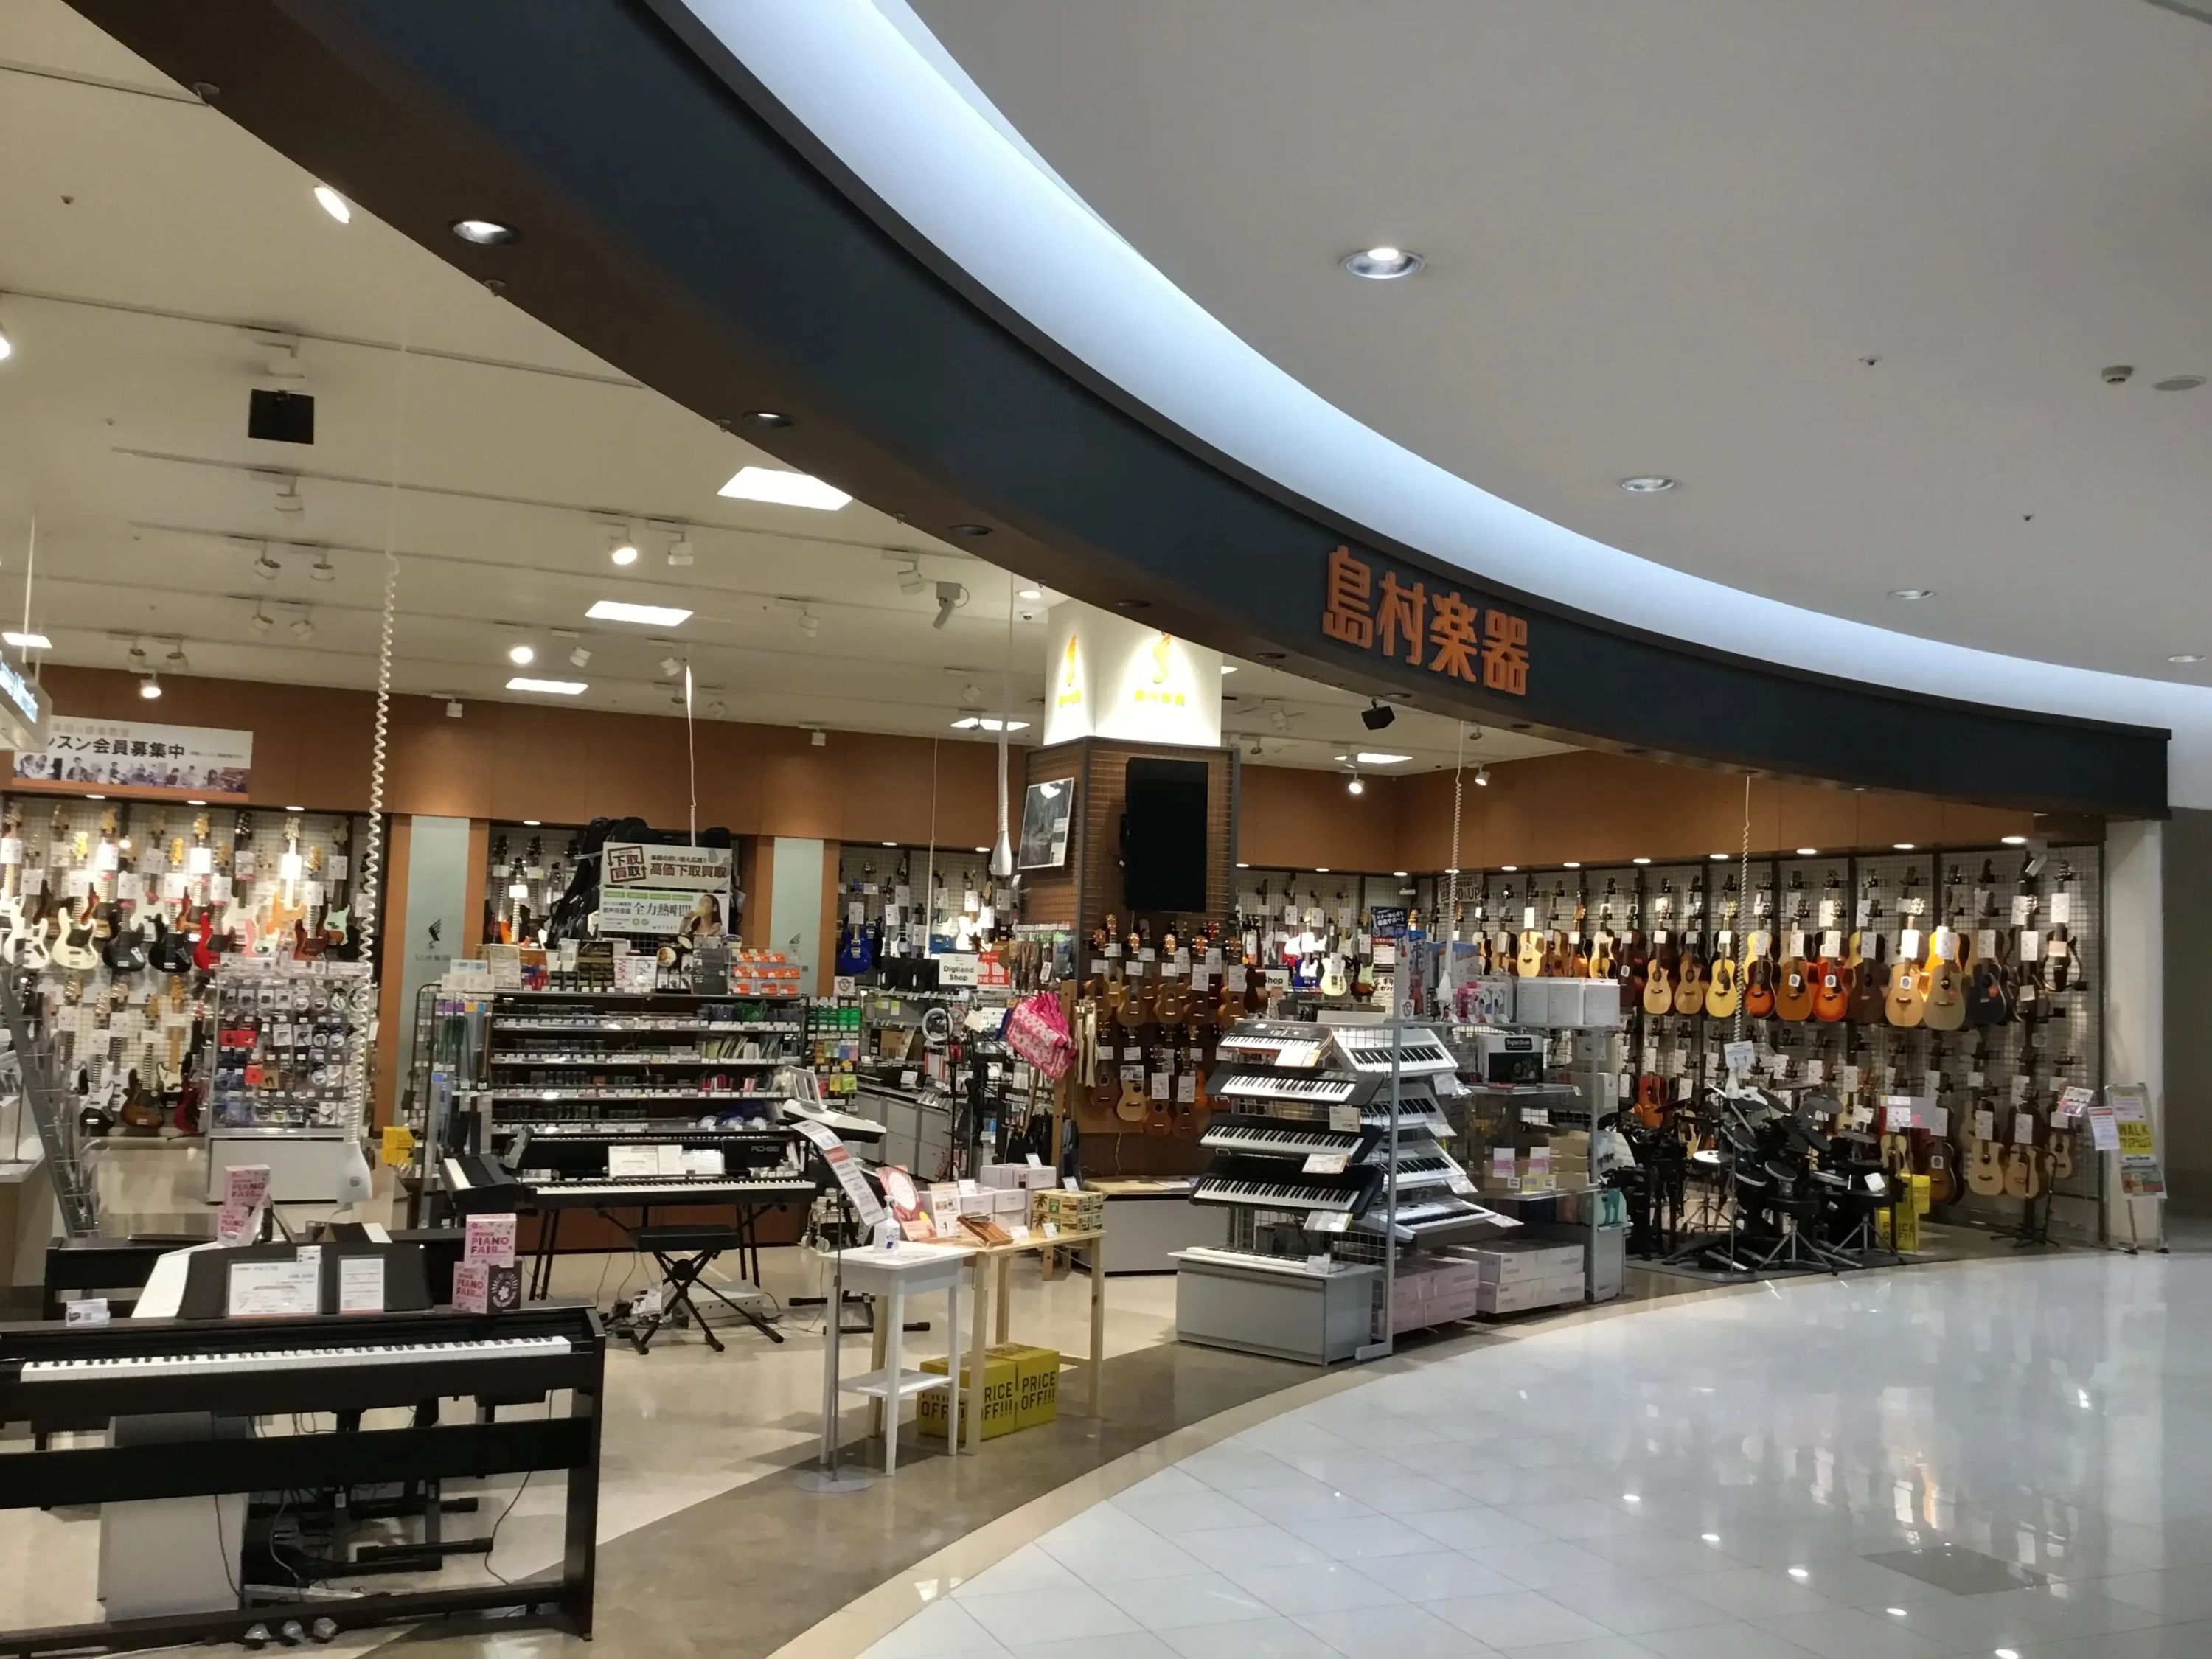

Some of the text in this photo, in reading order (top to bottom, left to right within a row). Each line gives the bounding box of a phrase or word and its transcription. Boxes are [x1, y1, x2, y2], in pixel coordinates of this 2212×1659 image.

[1322, 544, 1530, 696] 島村楽器
[49, 735, 185, 760] スン会員募集中
[943, 965, 974, 973] Digiland
[949, 973, 968, 981] Shop
[471, 1237, 509, 1245] PIANO
[470, 1245, 498, 1254] FAIR
[456, 1278, 484, 1290] PIANO
[456, 1287, 476, 1297] FAIR
[1021, 1371, 1057, 1394] PRICE
[984, 1381, 1013, 1402] RICE
[1020, 1388, 1056, 1411] OFF!!!
[981, 1399, 1013, 1422] FF!!!
